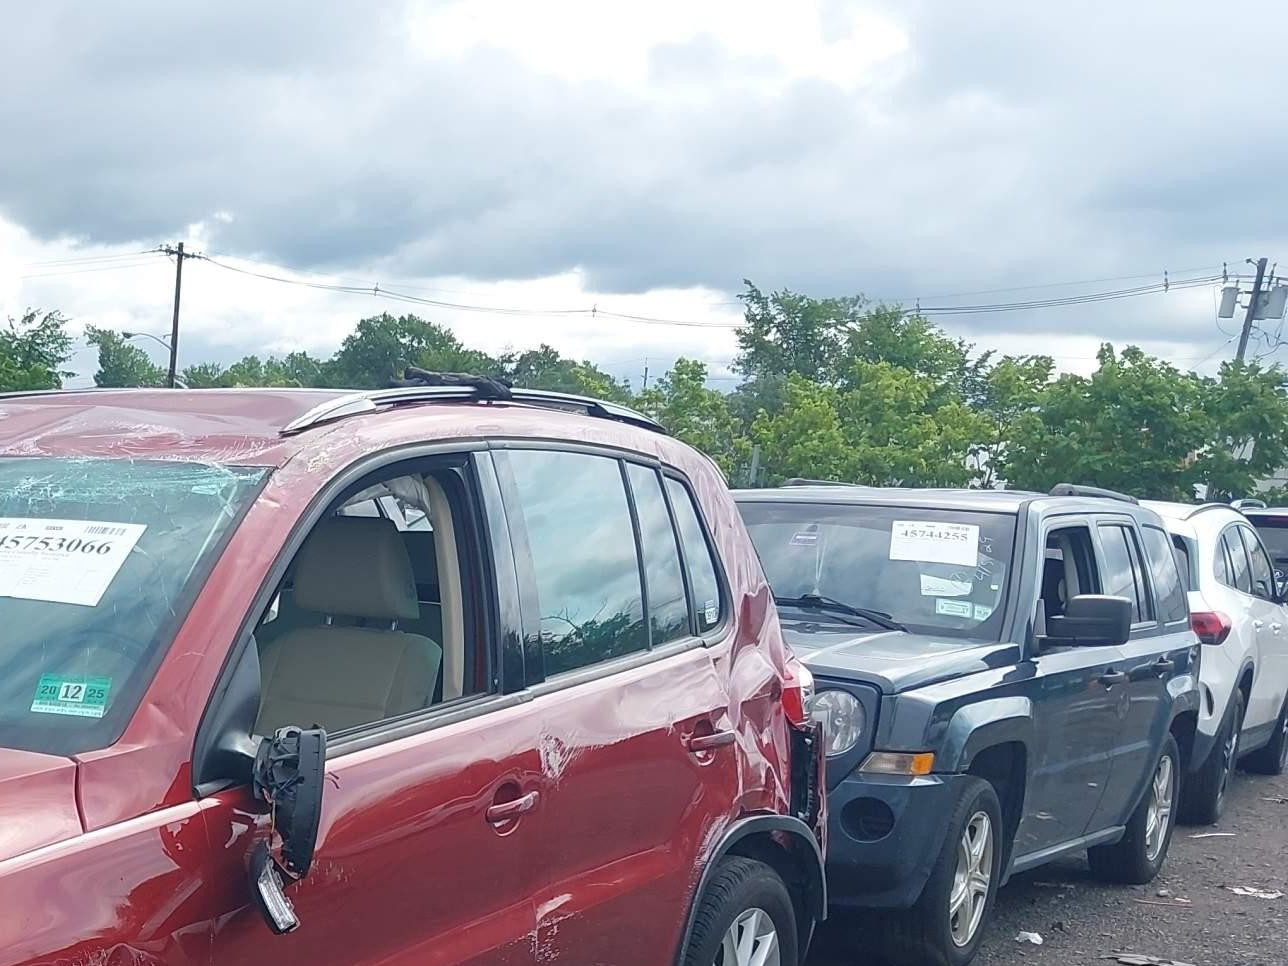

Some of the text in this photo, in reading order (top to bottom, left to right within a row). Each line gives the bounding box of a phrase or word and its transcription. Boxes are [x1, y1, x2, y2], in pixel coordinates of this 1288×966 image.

[901, 529, 968, 541] 45744255
[40, 684, 105, 699] 20 12 25
